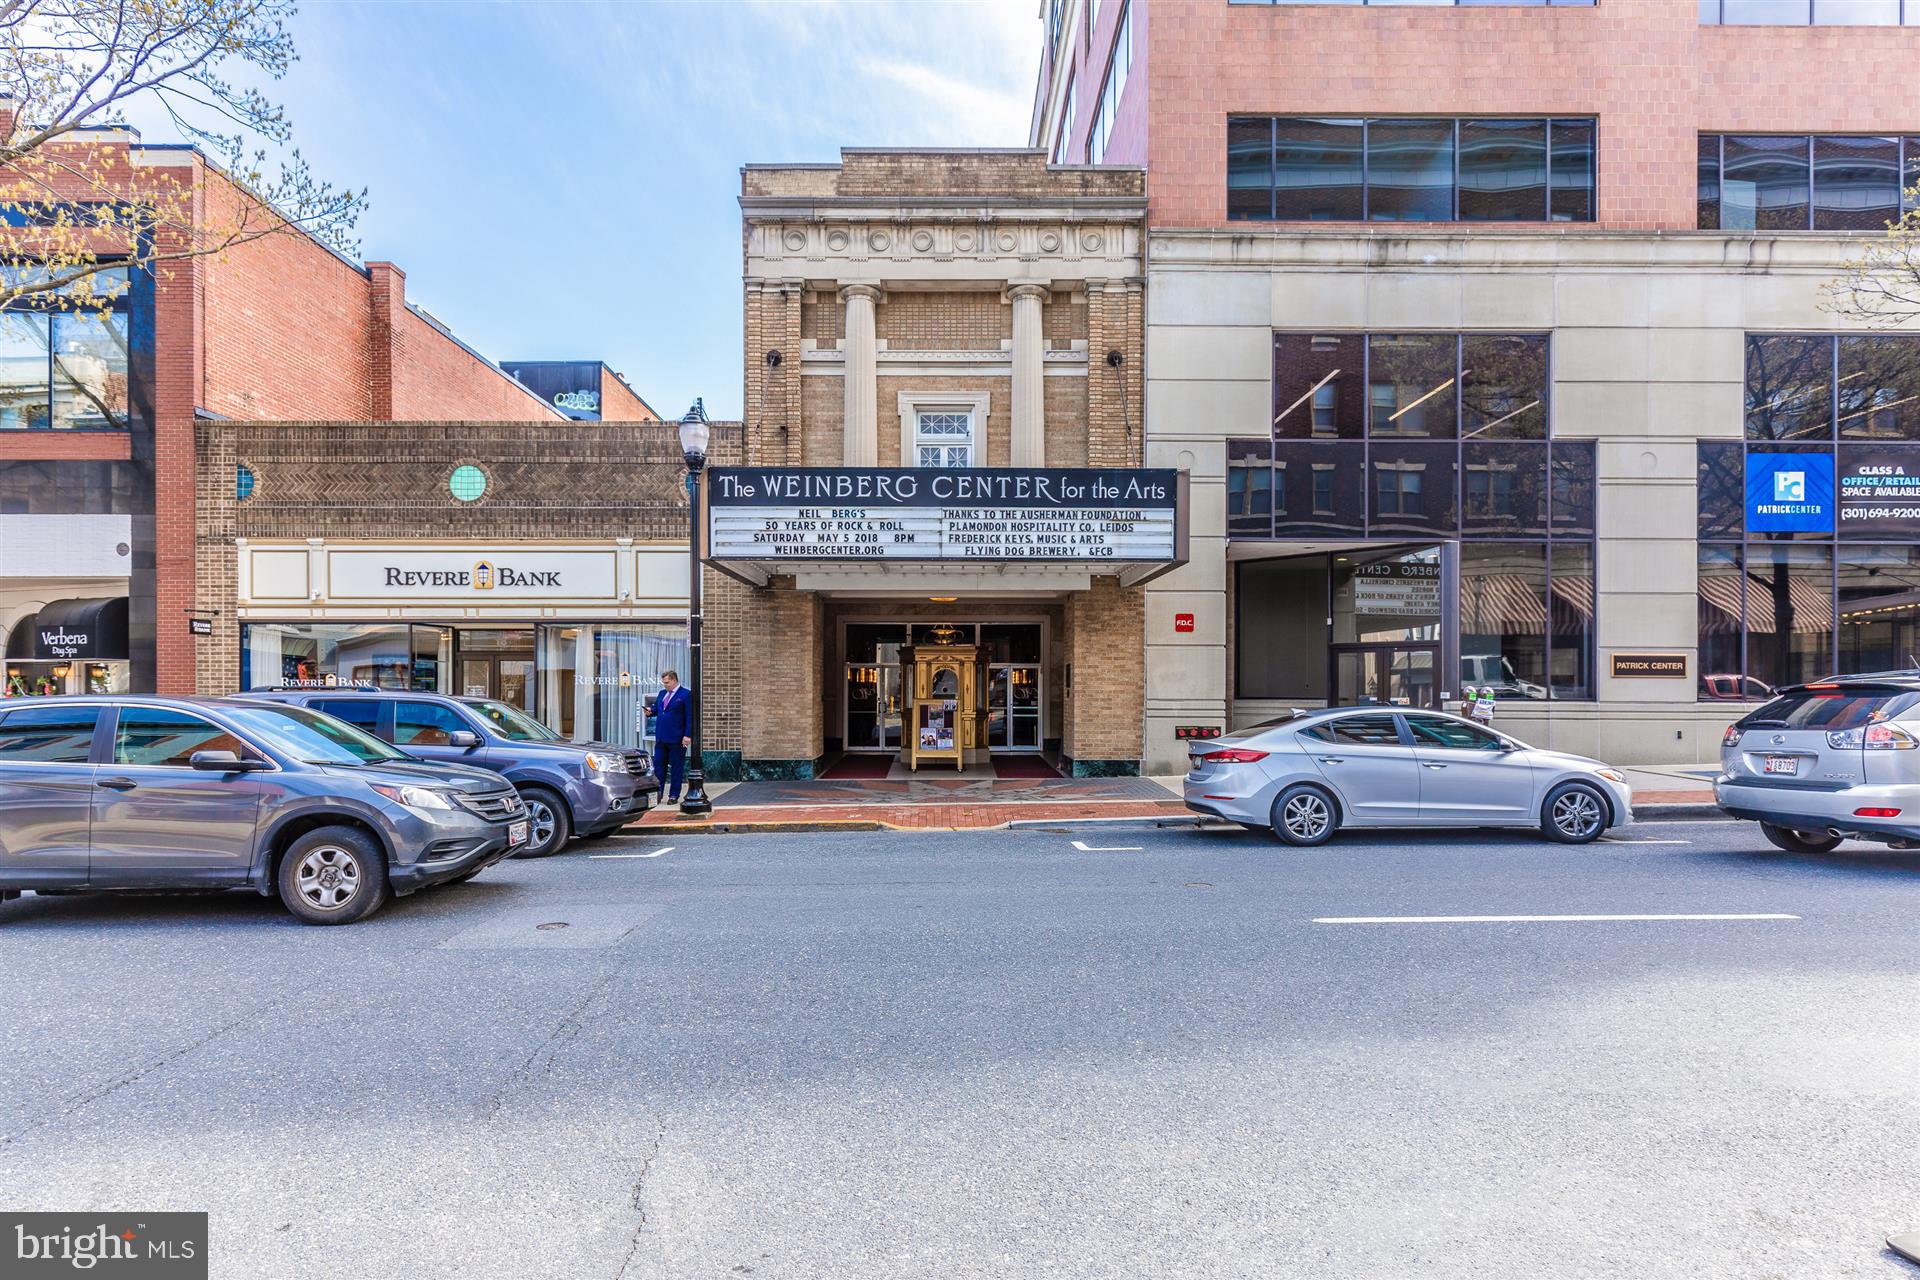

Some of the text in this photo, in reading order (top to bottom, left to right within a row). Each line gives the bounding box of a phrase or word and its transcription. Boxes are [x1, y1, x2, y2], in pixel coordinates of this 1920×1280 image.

[1859, 466, 1905, 475] CLASS A
[1842, 477, 1920, 486] OFFICE/RETAIL
[719, 475, 1165, 503] The WEINBERG CENTER for the Arts
[1842, 487, 1920, 497] SPACE AVAILABLE
[799, 510, 866, 518] NEIL BERG'S
[1757, 505, 1821, 514] PATRICKCENTER
[943, 510, 979, 519] THANKS
[983, 510, 996, 519] TO
[1000, 510, 1016, 519] THE
[1021, 510, 1078, 520] AUSHERMAN
[765, 521, 904, 530] 50 YEARS OF ROCK & ROLL
[950, 522, 1007, 531] PLAMONDON
[1010, 522, 1075, 532] HOSPITALITY
[1100, 523, 1134, 532] LEIDOS
[753, 533, 915, 542] SATURDAY MAY 5 2018 8PM
[949, 534, 1001, 543] FREDERICK
[1037, 534, 1067, 543] MUSIC
[1070, 535, 1076, 543] &
[1079, 535, 1104, 543] ARTS
[775, 545, 884, 555] WEINBERGCENTER.ORG
[965, 547, 1000, 556] FLYING
[1005, 547, 1024, 556] DOG
[384, 567, 562, 586] REVERE BANK
[42, 626, 87, 645] Verbena
[52, 646, 77, 657] Day Spa
[280, 677, 371, 687] REVERE BANK
[574, 674, 664, 685] REVERE BANK
